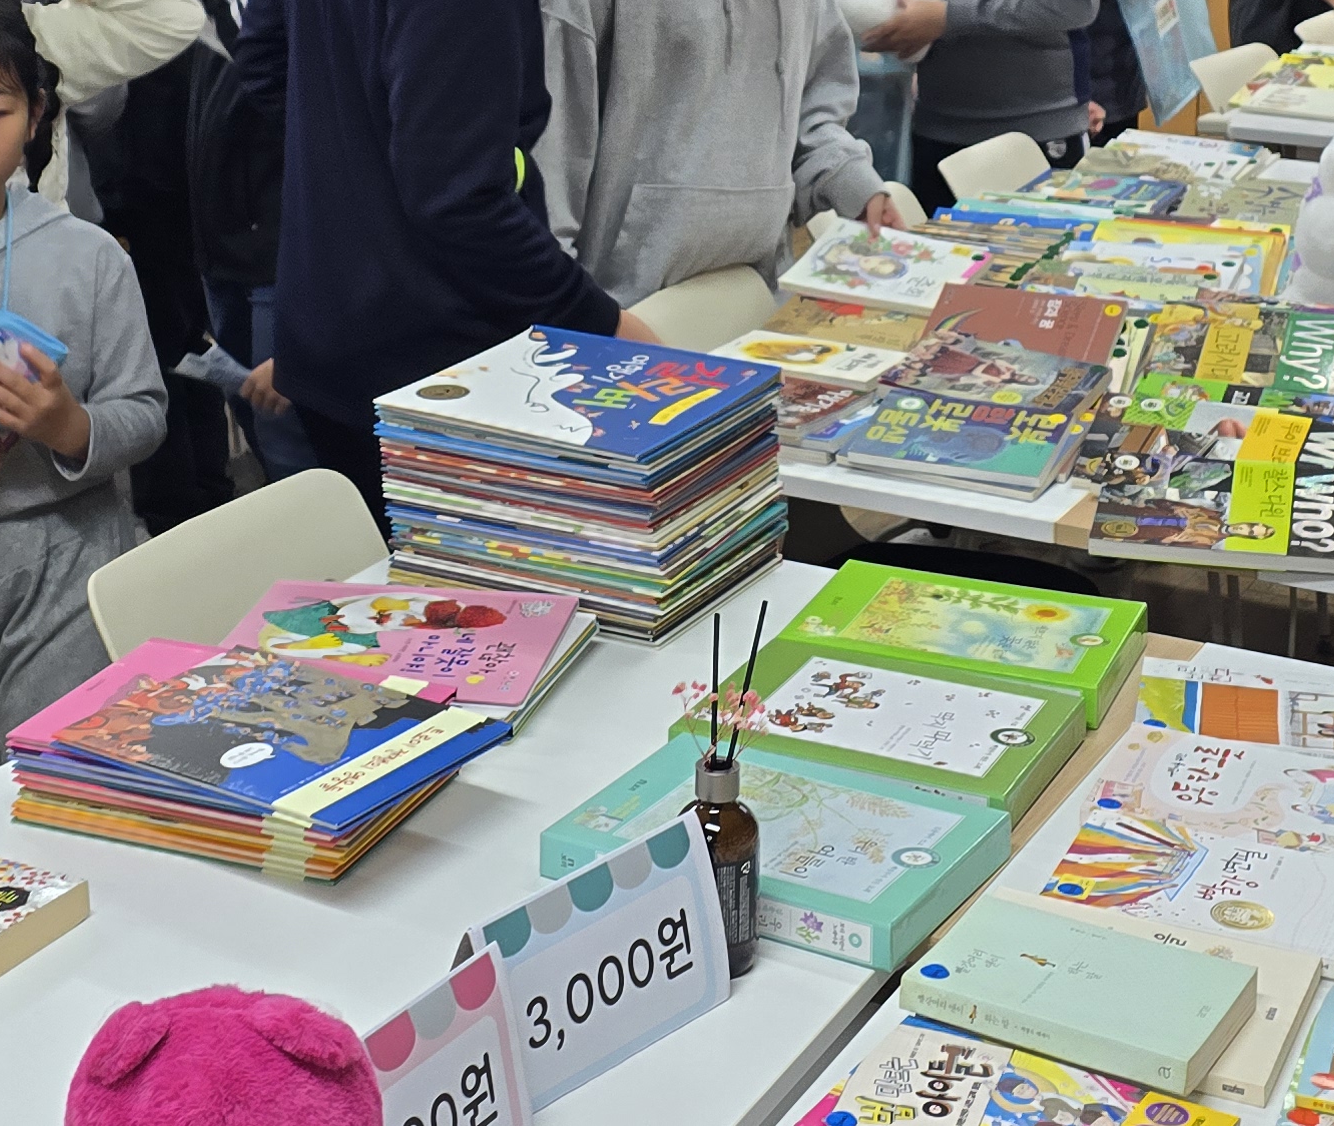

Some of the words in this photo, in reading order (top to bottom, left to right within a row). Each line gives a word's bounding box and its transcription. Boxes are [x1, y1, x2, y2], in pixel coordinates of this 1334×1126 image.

[592, 354, 649, 382] 여행기
[863, 409, 923, 443] 동생
[916, 397, 979, 433] 로봇
[1277, 423, 1303, 444] 루이
[1264, 469, 1289, 492] 찰스
[1259, 494, 1283, 518] 다윈
[401, 636, 440, 673] 아니야!
[431, 644, 476, 677] 잘못이
[922, 709, 959, 730] 딱지
[403, 726, 445, 746] 트로이
[901, 727, 956, 761] 따먹기
[1171, 781, 1219, 806] 우동
[777, 841, 842, 880] 여름이
[1220, 848, 1268, 874] 연필
[1194, 874, 1260, 901] 빨강
[526, 907, 694, 1051] 3,000원
[984, 1014, 1000, 1026] 하는
[857, 1056, 930, 1098] 만드는
[890, 1041, 1004, 1118] 아이들
[836, 1095, 925, 1124] 법
